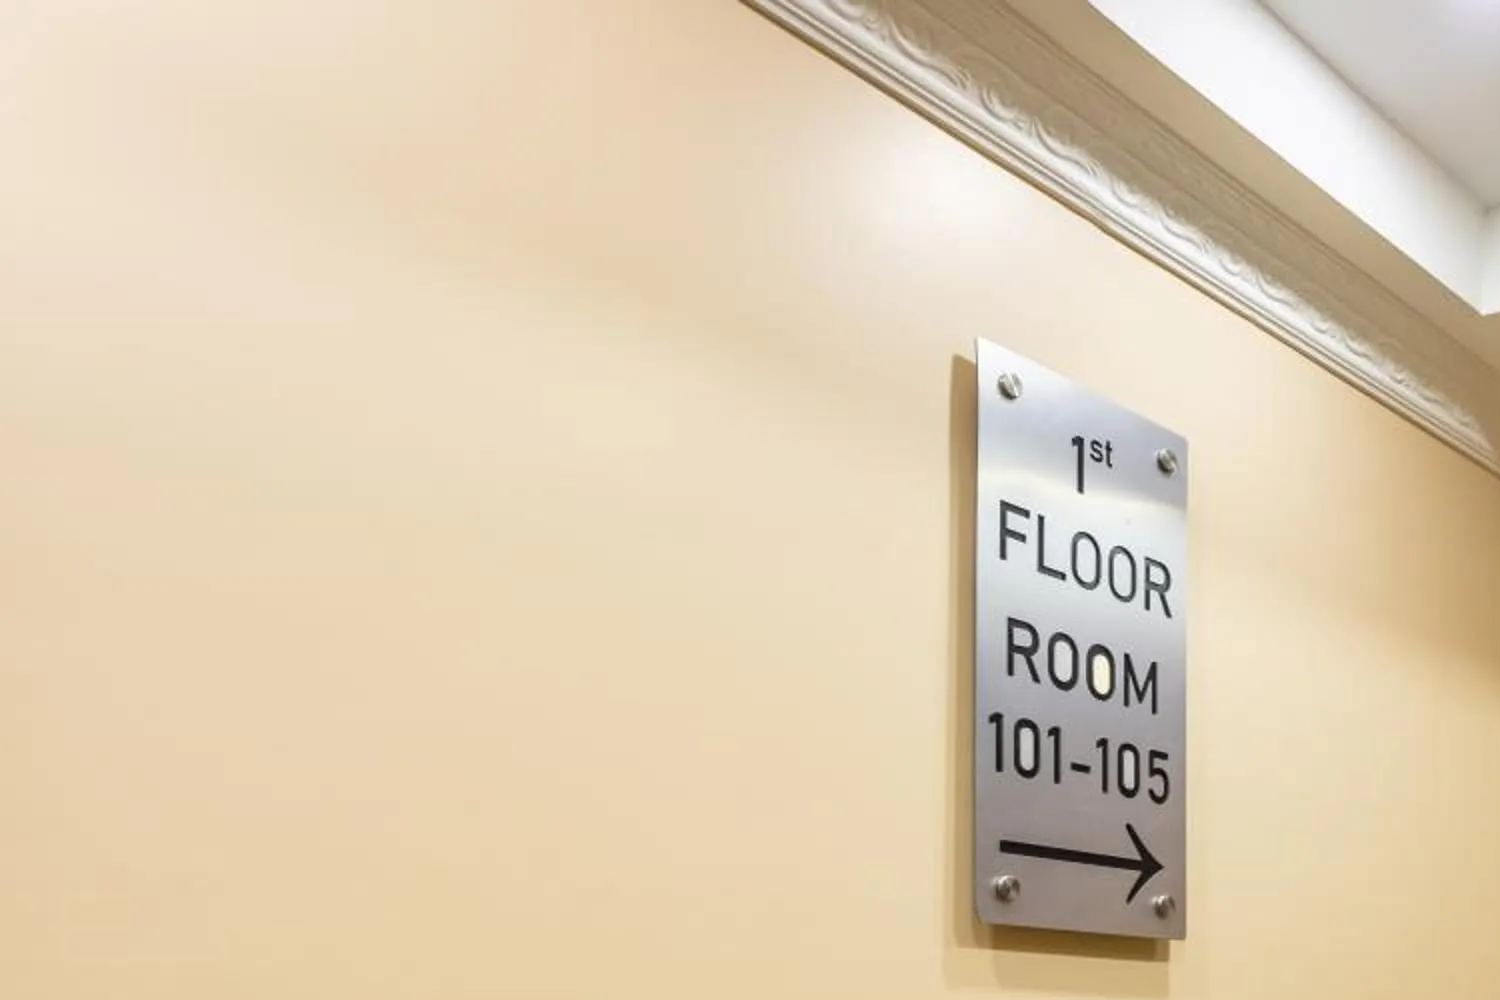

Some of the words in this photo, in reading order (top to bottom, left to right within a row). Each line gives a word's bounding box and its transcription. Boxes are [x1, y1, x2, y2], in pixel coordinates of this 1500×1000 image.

[1071, 435, 1113, 494] 1st
[999, 499, 1173, 618] FLOOR
[1006, 617, 1158, 715] ROOM
[988, 711, 1170, 805] 101-105
